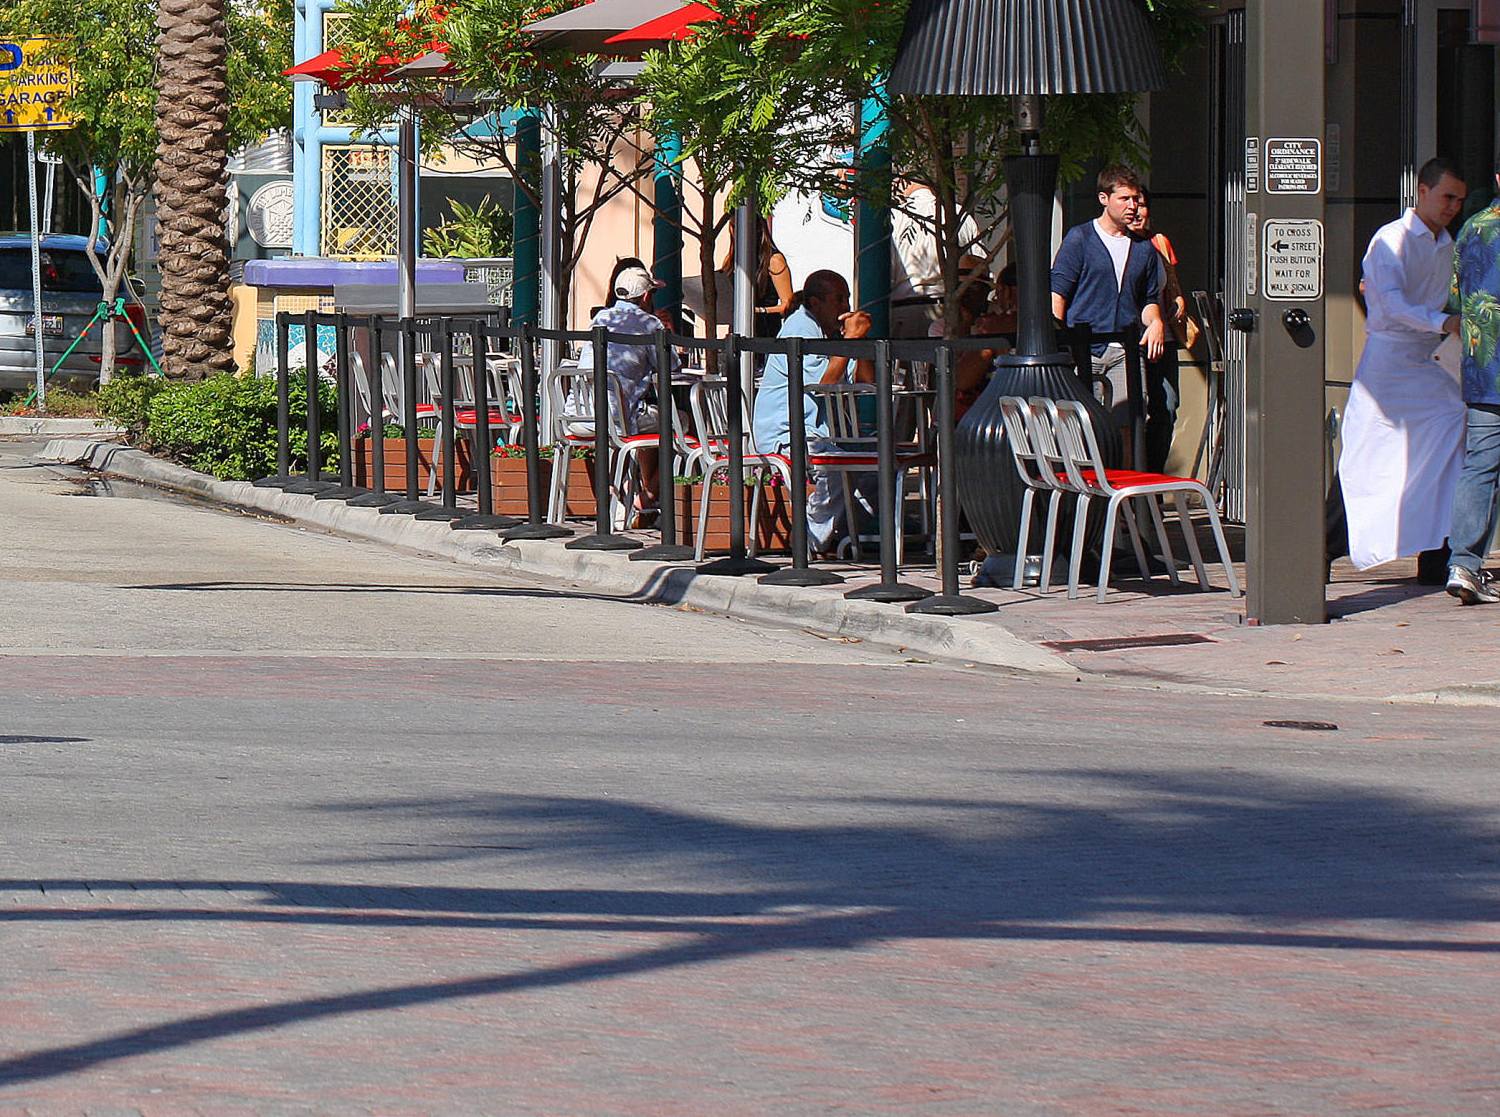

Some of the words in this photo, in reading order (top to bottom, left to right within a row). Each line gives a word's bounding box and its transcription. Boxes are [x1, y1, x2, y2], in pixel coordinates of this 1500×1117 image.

[1275, 228, 1285, 237] TO
[1286, 228, 1312, 237] CROSS
[1291, 242, 1317, 251] STREET
[1269, 255, 1289, 264] PUSH
[1290, 255, 1317, 264] BUTTON
[1274, 269, 1293, 278] WAIT
[1295, 269, 1311, 278] FOR
[1270, 283, 1289, 292] WALK
[1291, 283, 1316, 292] SIGNAL
